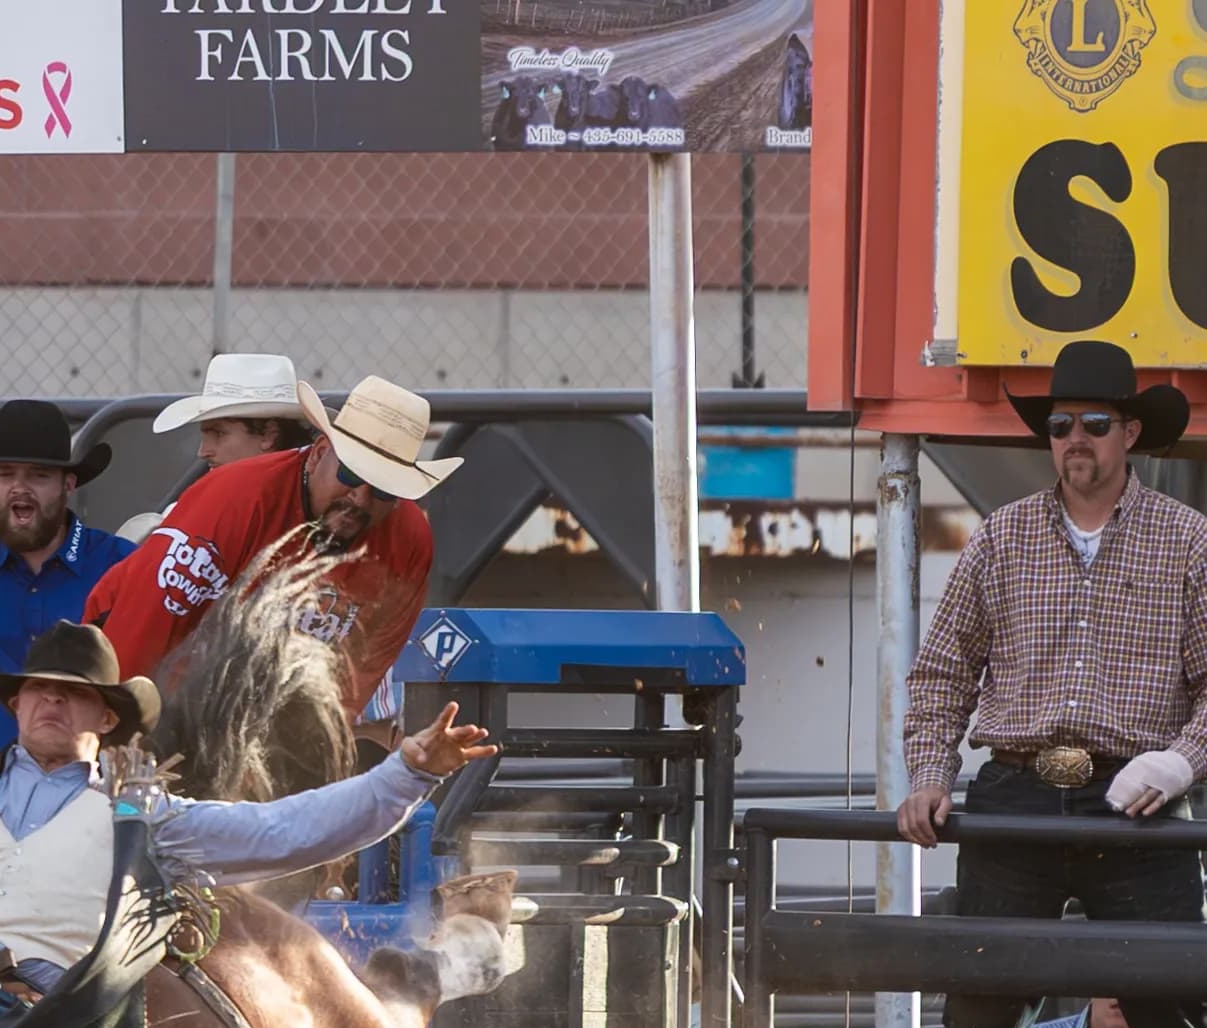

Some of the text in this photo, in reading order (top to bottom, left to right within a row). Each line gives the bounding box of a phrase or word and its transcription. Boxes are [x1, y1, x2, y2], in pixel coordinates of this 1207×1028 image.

[193, 28, 414, 82] FARMS
[508, 47, 613, 75] Timeless Quality
[1040, 52, 1129, 95] INTERNATIONAL
[528, 127, 565, 144] Mike
